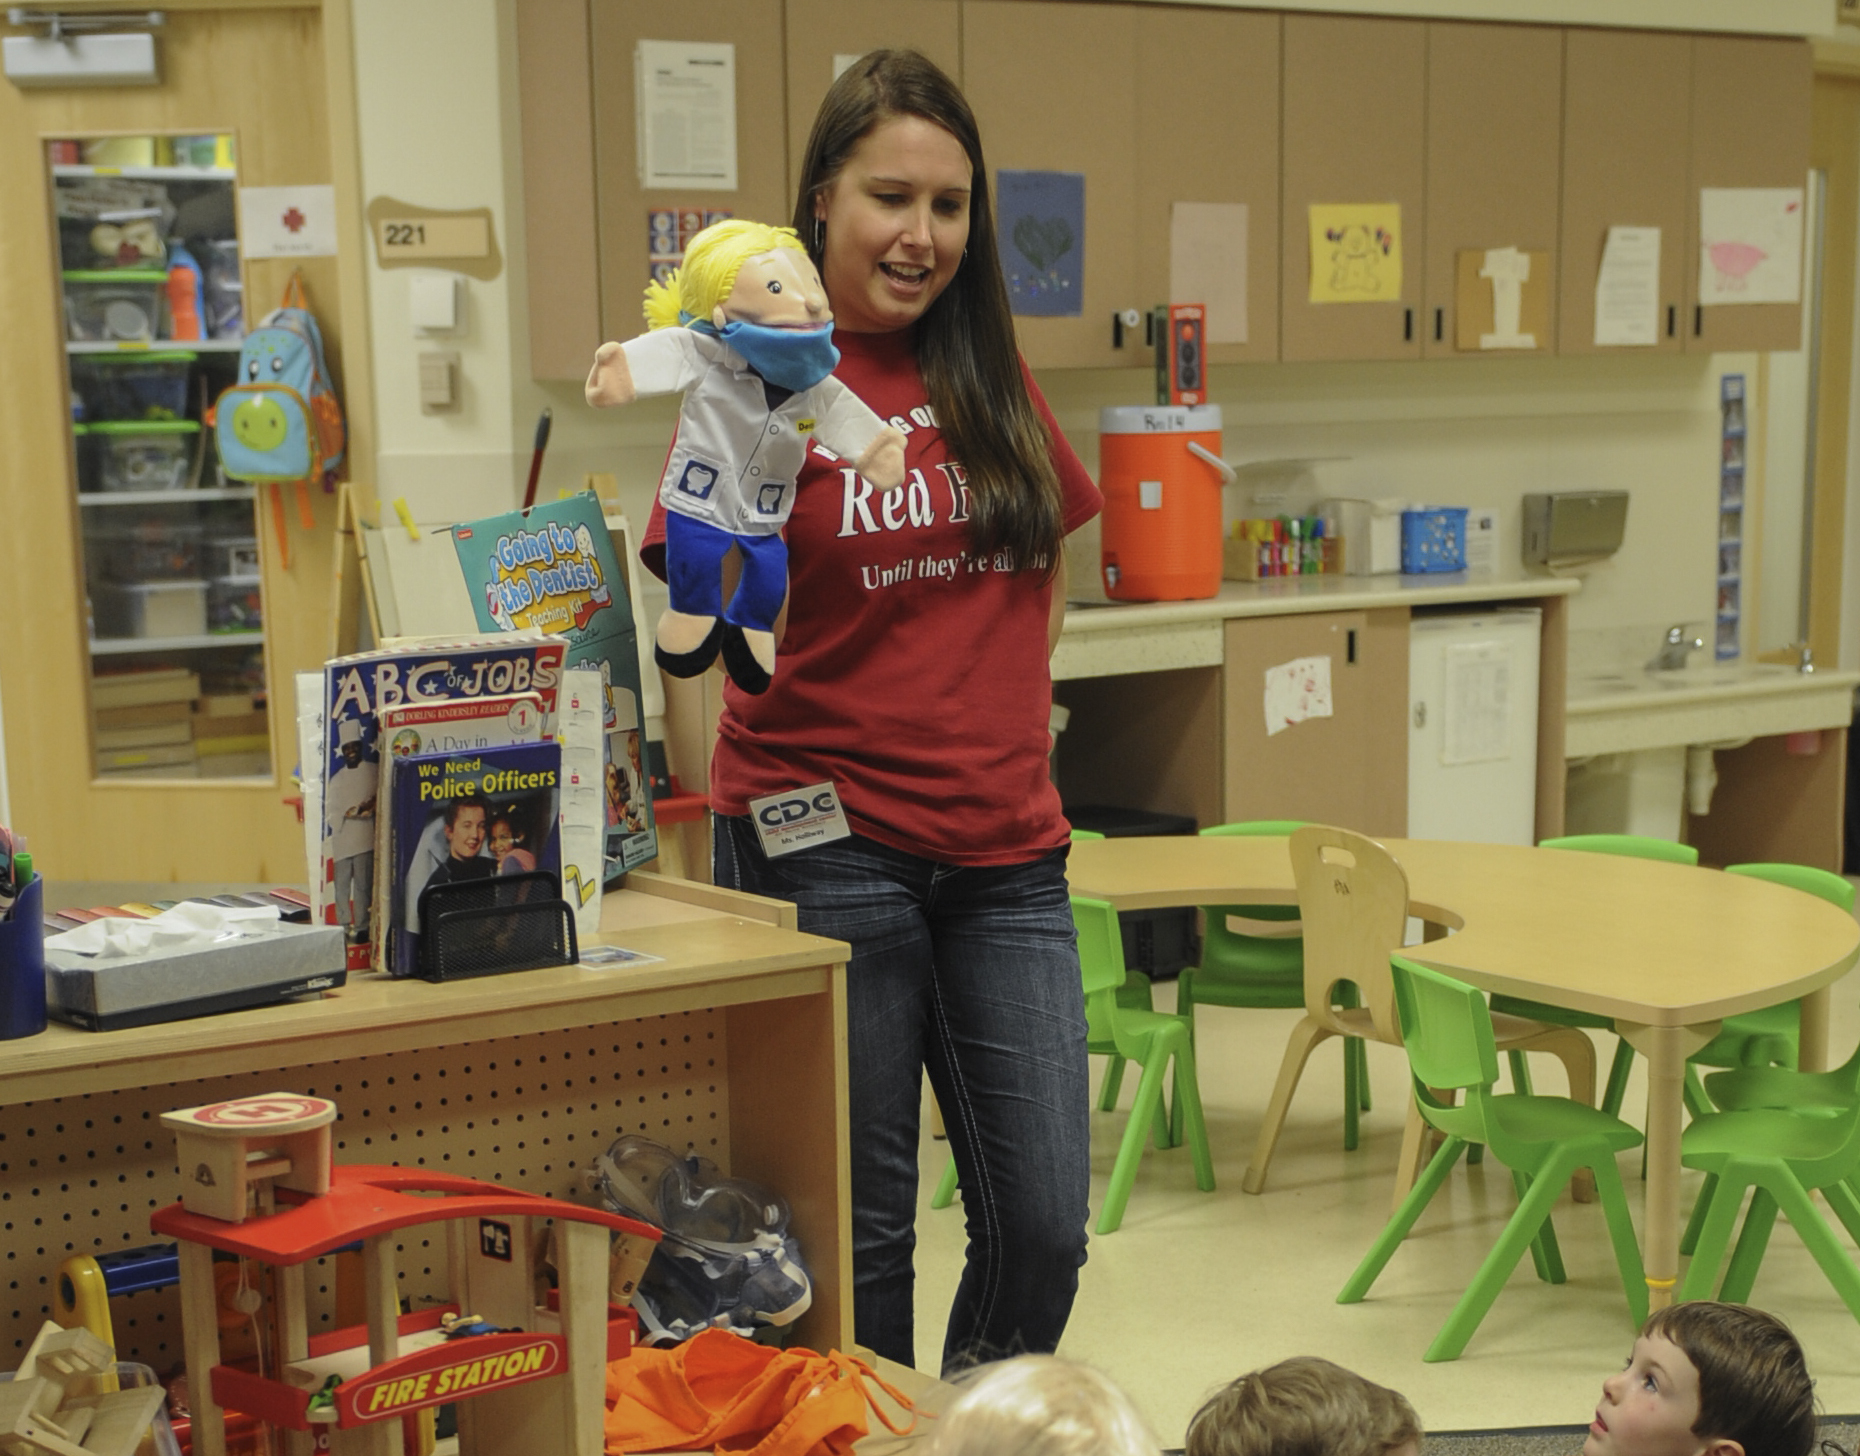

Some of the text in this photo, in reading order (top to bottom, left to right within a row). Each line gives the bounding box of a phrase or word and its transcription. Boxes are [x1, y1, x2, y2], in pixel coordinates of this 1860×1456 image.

[386, 223, 425, 245] 221
[836, 467, 935, 538] Red
[497, 521, 576, 571] Going to
[497, 558, 599, 614] the Dentist
[861, 555, 913, 590] Until
[526, 600, 584, 628] Teaching Kit
[331, 655, 558, 720] ABC OF JOBS
[518, 709, 526, 726] 1
[426, 734, 488, 752] A Day in
[418, 757, 481, 778] We Need
[420, 777, 476, 802] Police
[482, 769, 556, 794] Officers
[759, 792, 836, 826] CDC
[369, 1346, 547, 1412] FIRE STATION
